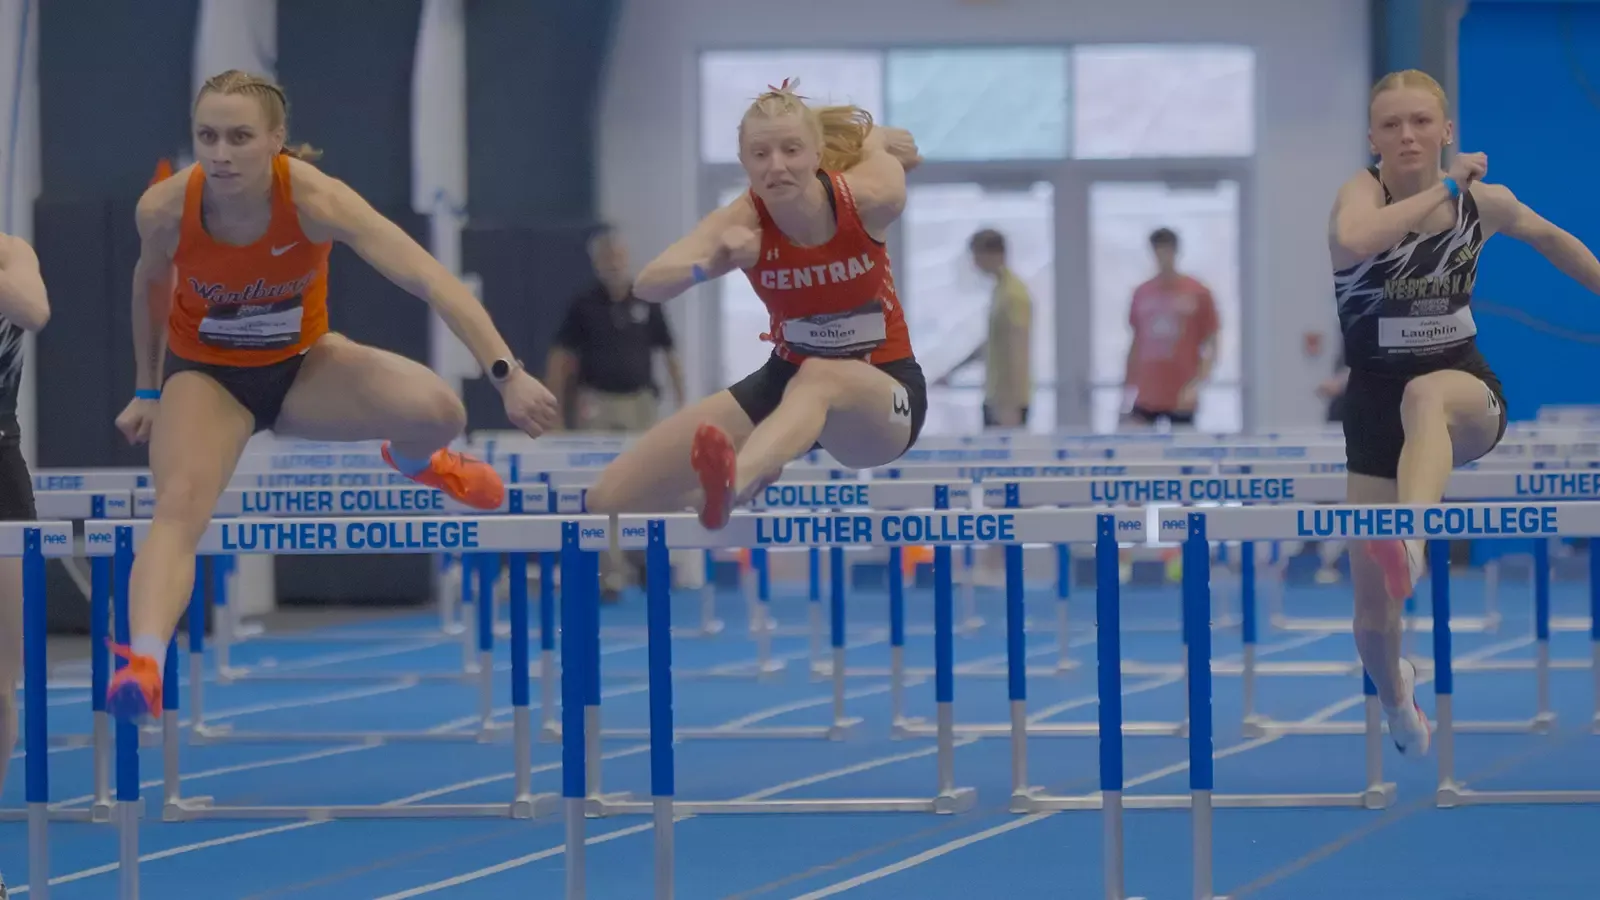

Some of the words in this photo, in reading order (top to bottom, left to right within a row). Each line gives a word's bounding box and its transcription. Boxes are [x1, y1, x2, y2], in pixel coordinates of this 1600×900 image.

[761, 253, 875, 290] CENTRAL
[1384, 273, 1472, 300] NEBRASKA
[1401, 326, 1457, 339] Laughlin
[242, 491, 333, 512] LUTHER
[340, 490, 444, 511] COLLEGE
[764, 485, 869, 506] COLLEGE
[1090, 480, 1182, 501] LUTHER
[1189, 478, 1294, 499] COLLEGE
[222, 523, 337, 549] LUTHER
[346, 521, 479, 549] COLLEGE
[756, 516, 872, 543] LUTHER
[881, 514, 1015, 542] COLLEGE
[1297, 508, 1414, 537] LUTHER
[1423, 507, 1558, 535] COLLEGE
